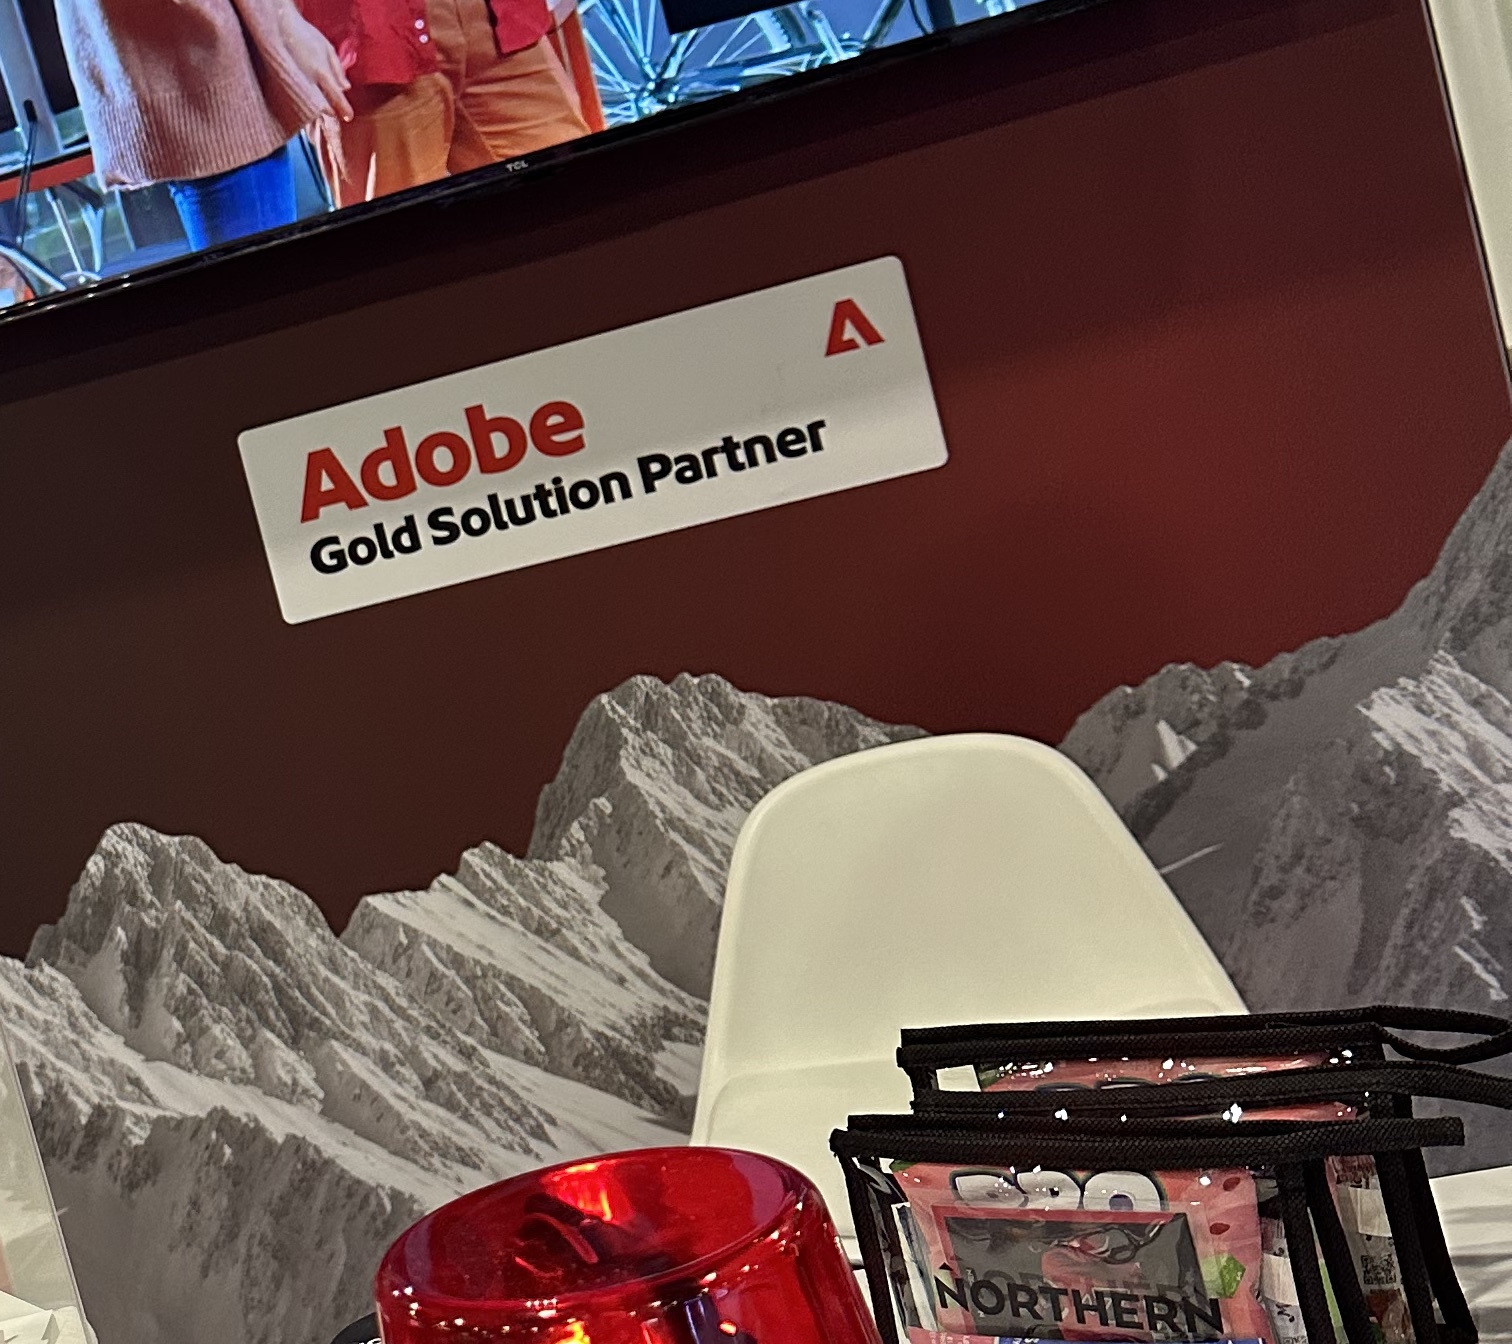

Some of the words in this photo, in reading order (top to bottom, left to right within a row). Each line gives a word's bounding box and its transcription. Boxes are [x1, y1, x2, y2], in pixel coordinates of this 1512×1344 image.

[505, 160, 529, 172] TCL
[299, 399, 587, 524] Adobe
[309, 515, 423, 576] Gold
[428, 469, 632, 545] Solution
[639, 419, 826, 496] Partner
[933, 1273, 1224, 1335] NORTHERN
